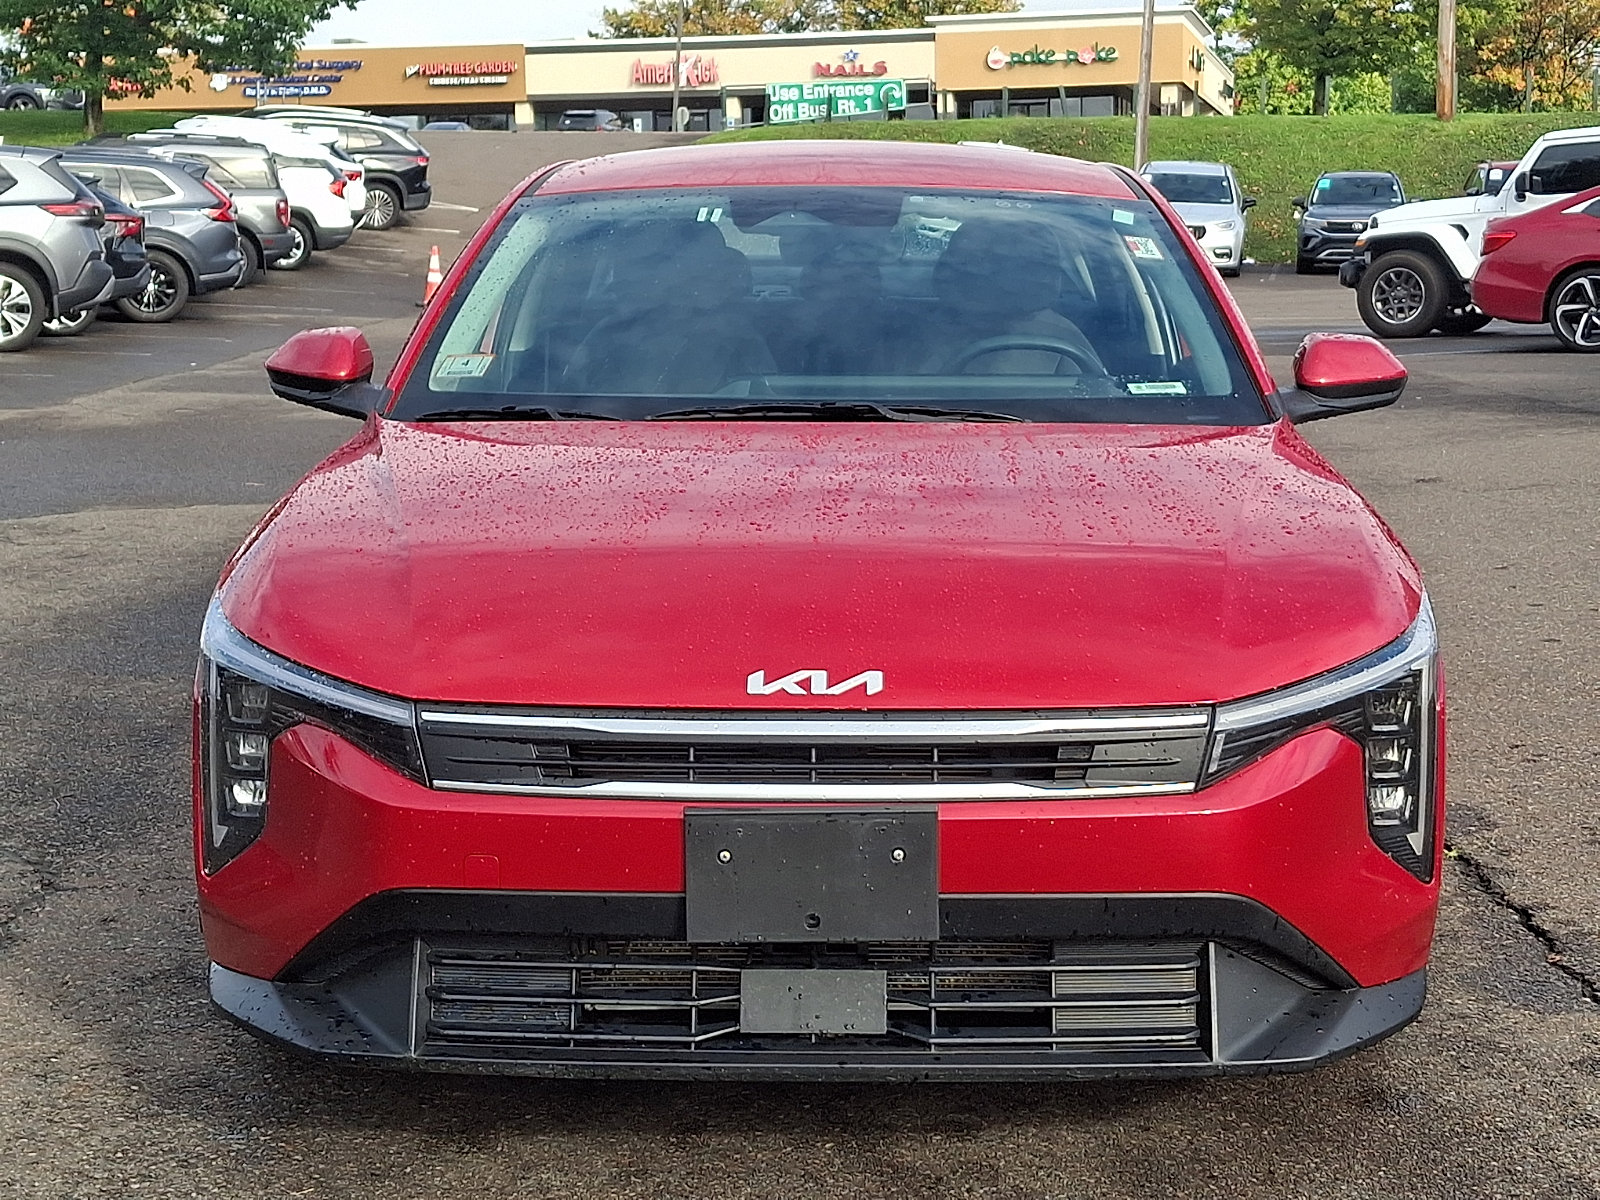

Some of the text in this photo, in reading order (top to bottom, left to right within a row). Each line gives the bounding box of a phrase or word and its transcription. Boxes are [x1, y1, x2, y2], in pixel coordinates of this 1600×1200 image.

[474, 61, 515, 74] GARDEN
[632, 54, 719, 87] AmeriKick
[815, 60, 888, 77] NAILS
[768, 83, 875, 102] Use Entrance
[769, 104, 794, 121] Off
[837, 99, 860, 114] Rt.
[864, 97, 872, 111] 1
[747, 669, 884, 696] KIA
